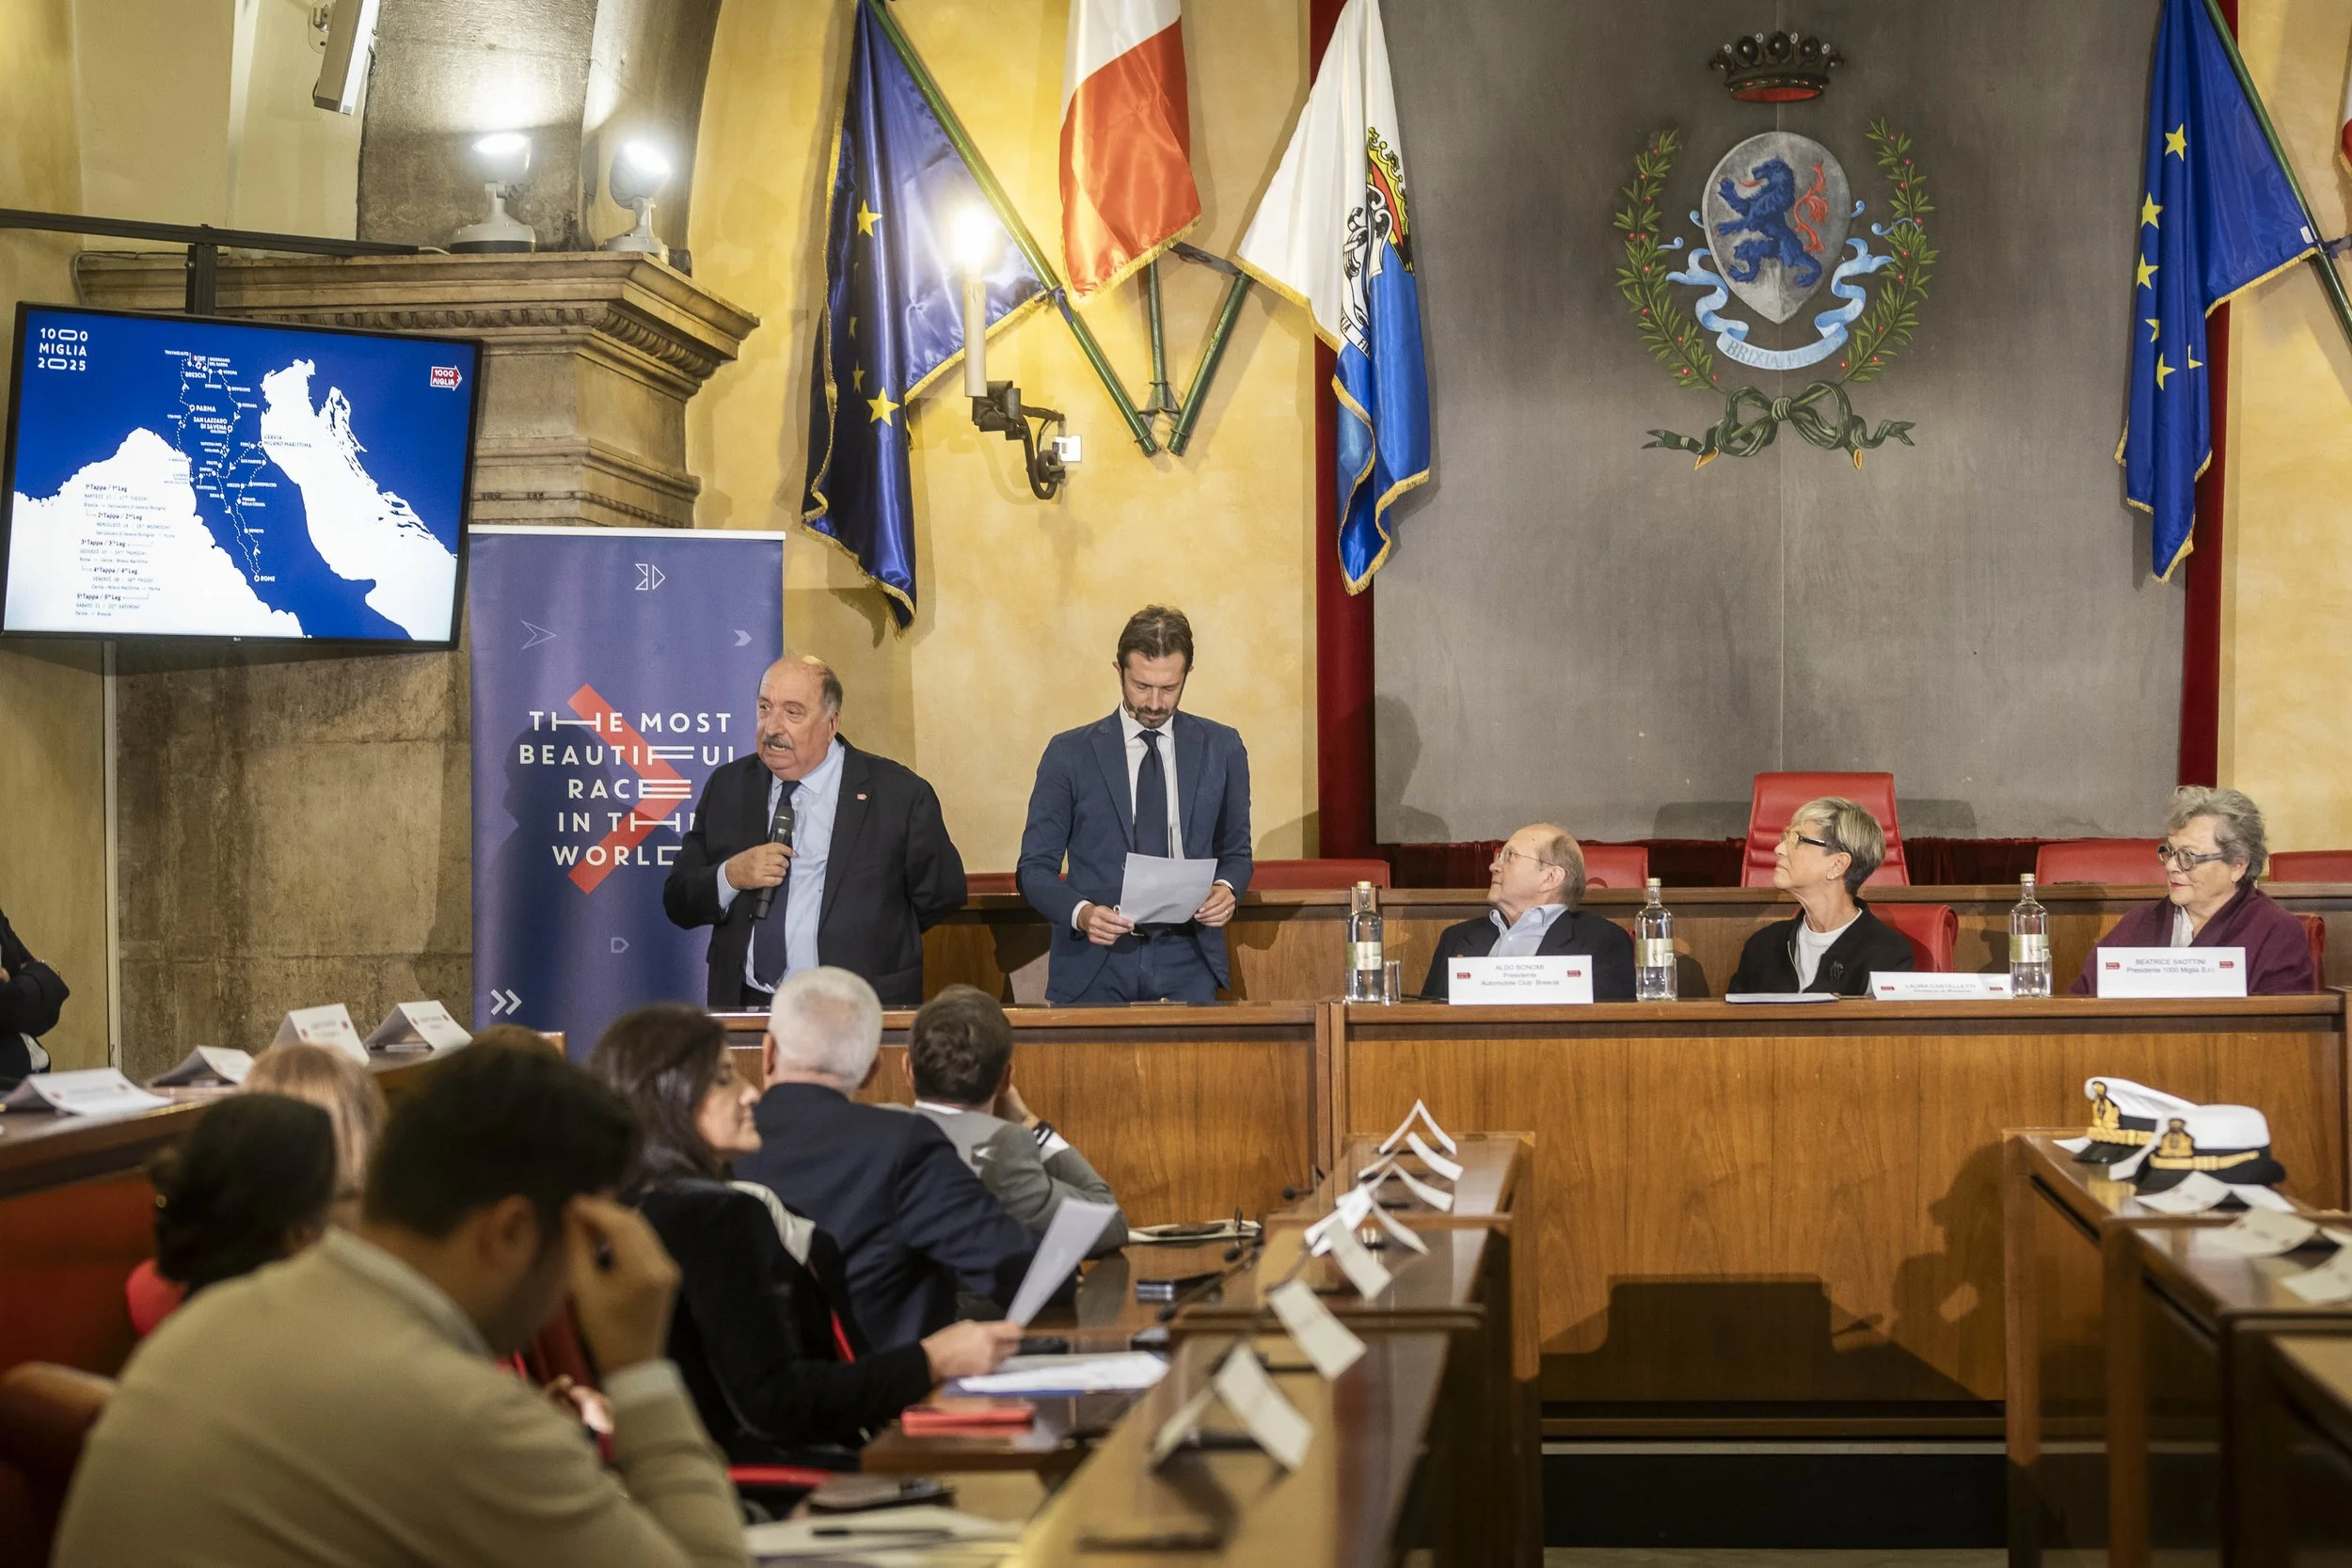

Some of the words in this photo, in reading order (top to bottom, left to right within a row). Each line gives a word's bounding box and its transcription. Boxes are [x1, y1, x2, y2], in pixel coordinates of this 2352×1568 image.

[40, 327, 88, 342] 1000
[39, 342, 87, 356] MIGLIA
[38, 356, 87, 372] 2025
[435, 369, 454, 377] 1000
[433, 377, 454, 386] MIGLIA
[529, 711, 624, 733] THE
[640, 712, 731, 733] MOST
[568, 779, 692, 799] RACE
[558, 812, 590, 832] IN
[607, 812, 696, 832] TH
